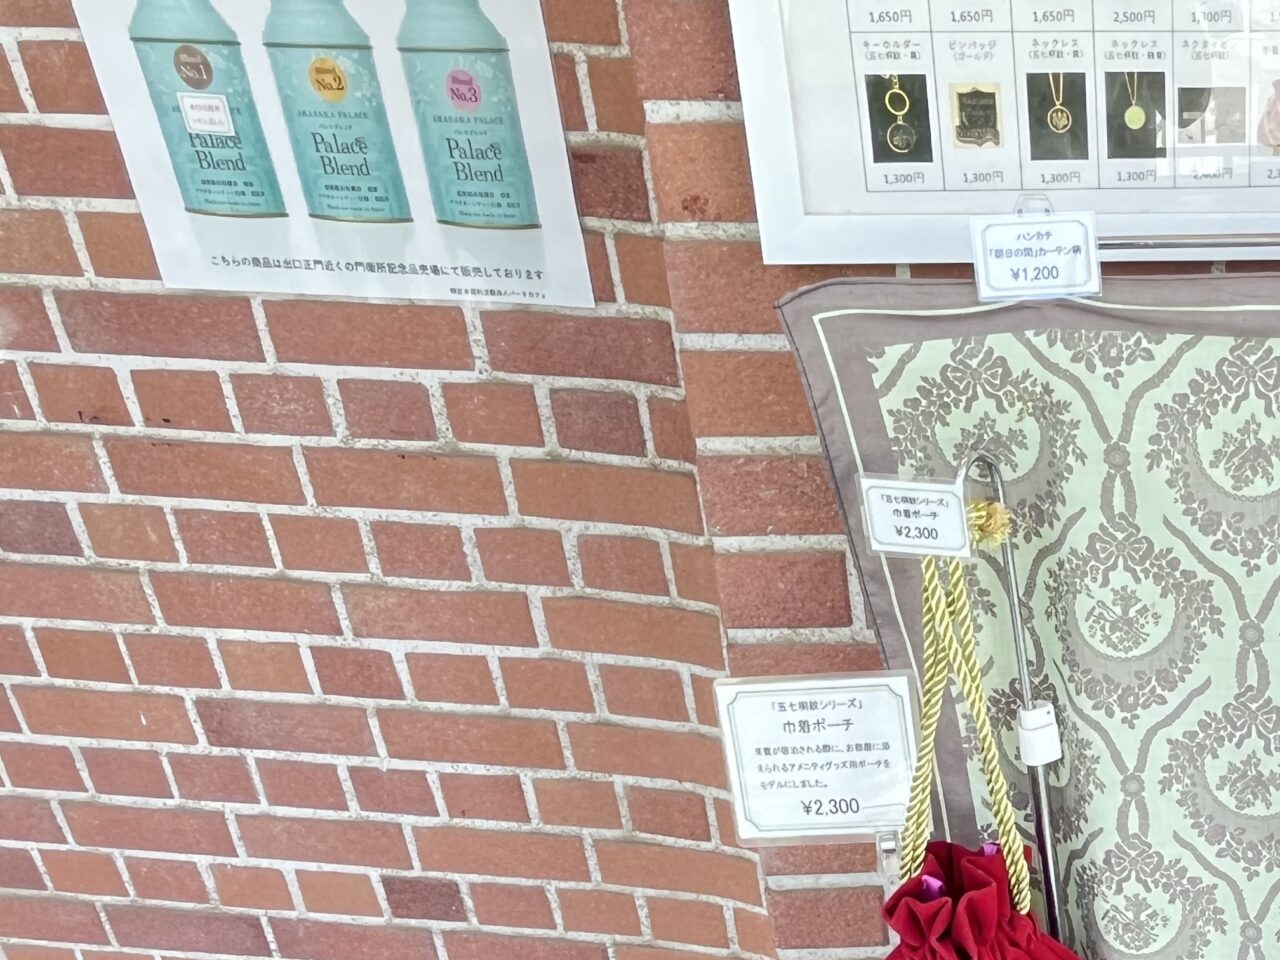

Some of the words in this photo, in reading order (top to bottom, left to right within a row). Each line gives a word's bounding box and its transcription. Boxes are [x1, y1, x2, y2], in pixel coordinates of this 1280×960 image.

[868, 9, 913, 24] 1,650円
[950, 9, 993, 24] 1,650円
[1032, 9, 1075, 24] 1,650円
[1113, 9, 1155, 24] 2,500円
[315, 74, 345, 91] No.2
[450, 87, 478, 103] No.3
[311, 131, 368, 155] Palace
[445, 137, 502, 161] Palace
[195, 150, 247, 172] Blend
[320, 155, 371, 177] Blend
[453, 161, 504, 182] Blend
[883, 171, 925, 185] 1,300円
[963, 171, 1004, 184] 1,300円
[1040, 171, 1081, 184] 1,300円
[1116, 169, 1157, 182] 1,300円
[1016, 231, 1053, 241] ハンカチ
[1010, 265, 1059, 281] ¥1,200
[894, 525, 938, 540] ¥2,300
[783, 717, 854, 734] 巾着ポーチ
[760, 779, 828, 790] モデルにしました。
[800, 798, 860, 817] ¥2,300
